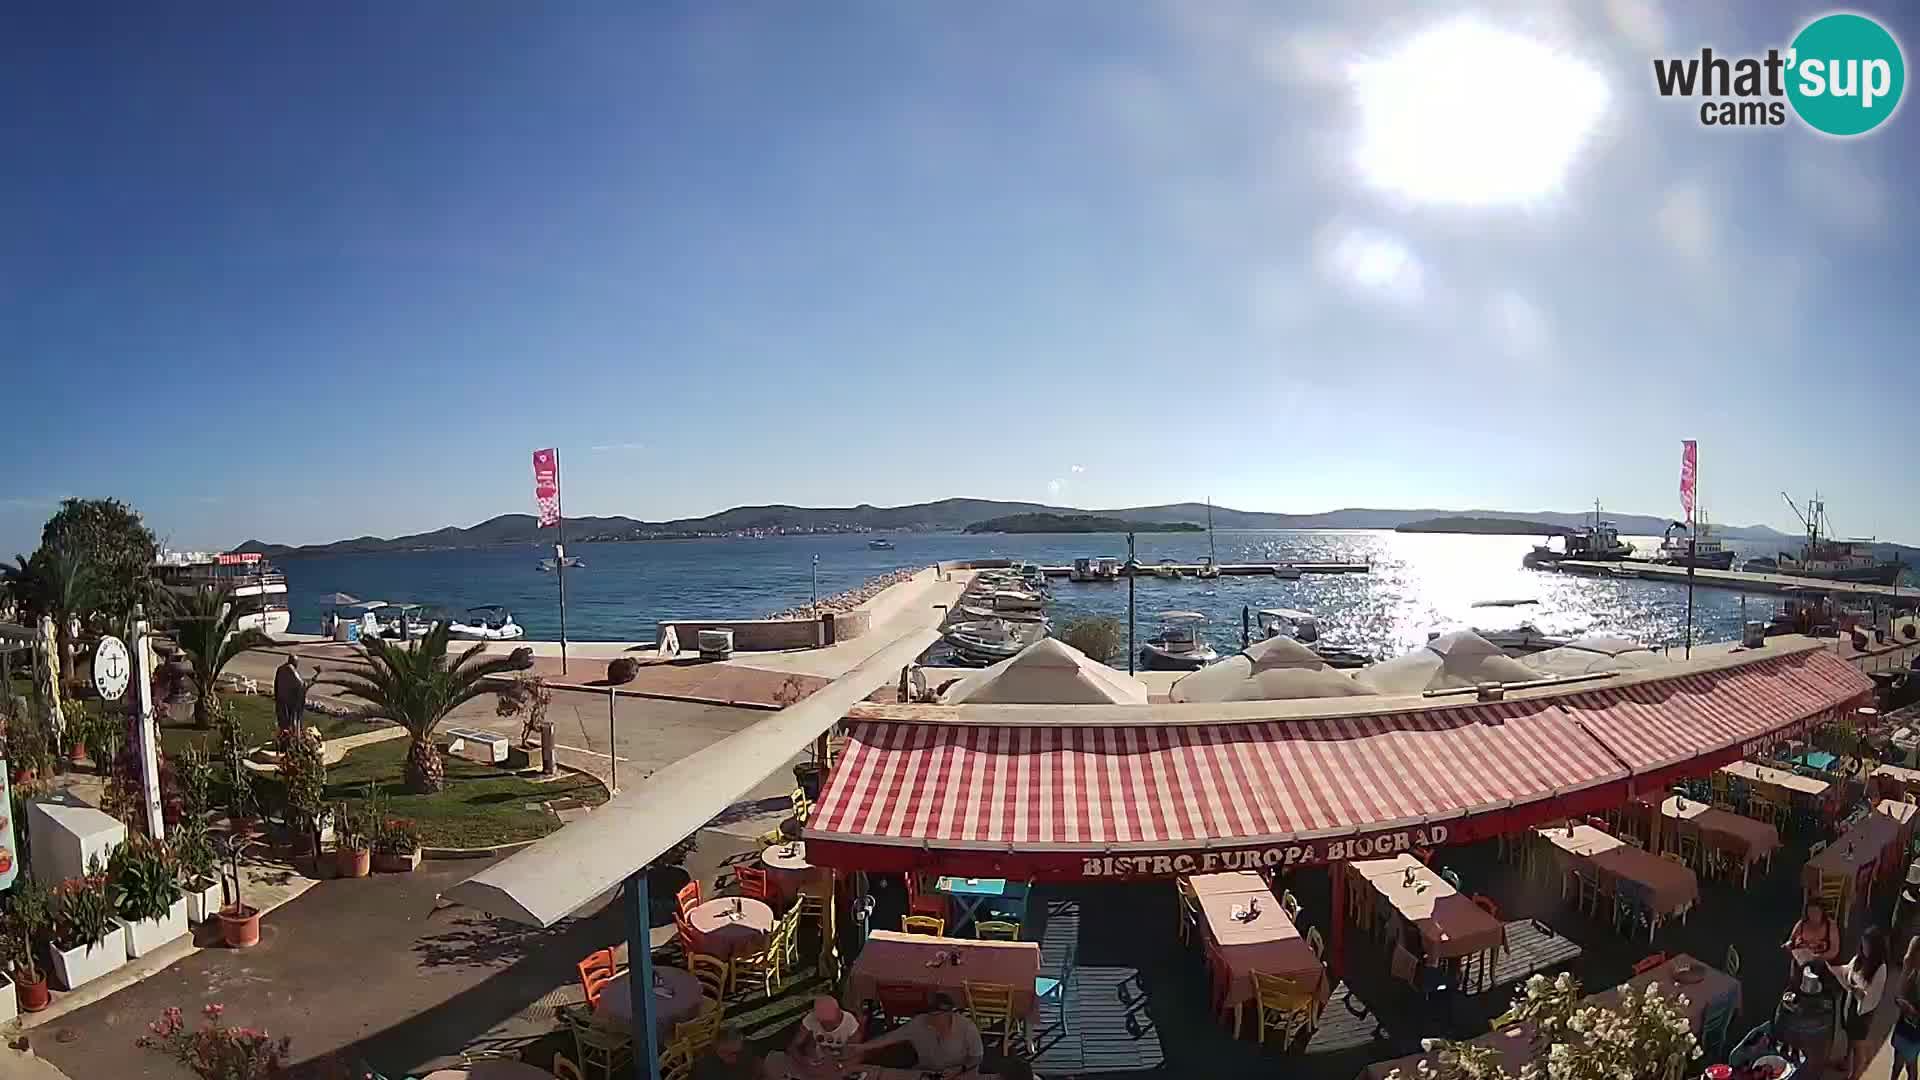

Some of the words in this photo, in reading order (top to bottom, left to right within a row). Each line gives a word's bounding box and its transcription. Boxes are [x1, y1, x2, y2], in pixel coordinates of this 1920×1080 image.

[1082, 854, 1197, 877] BISTRO
[1201, 844, 1321, 872] EUROPA
[1327, 826, 1448, 861] BIOGRAD
